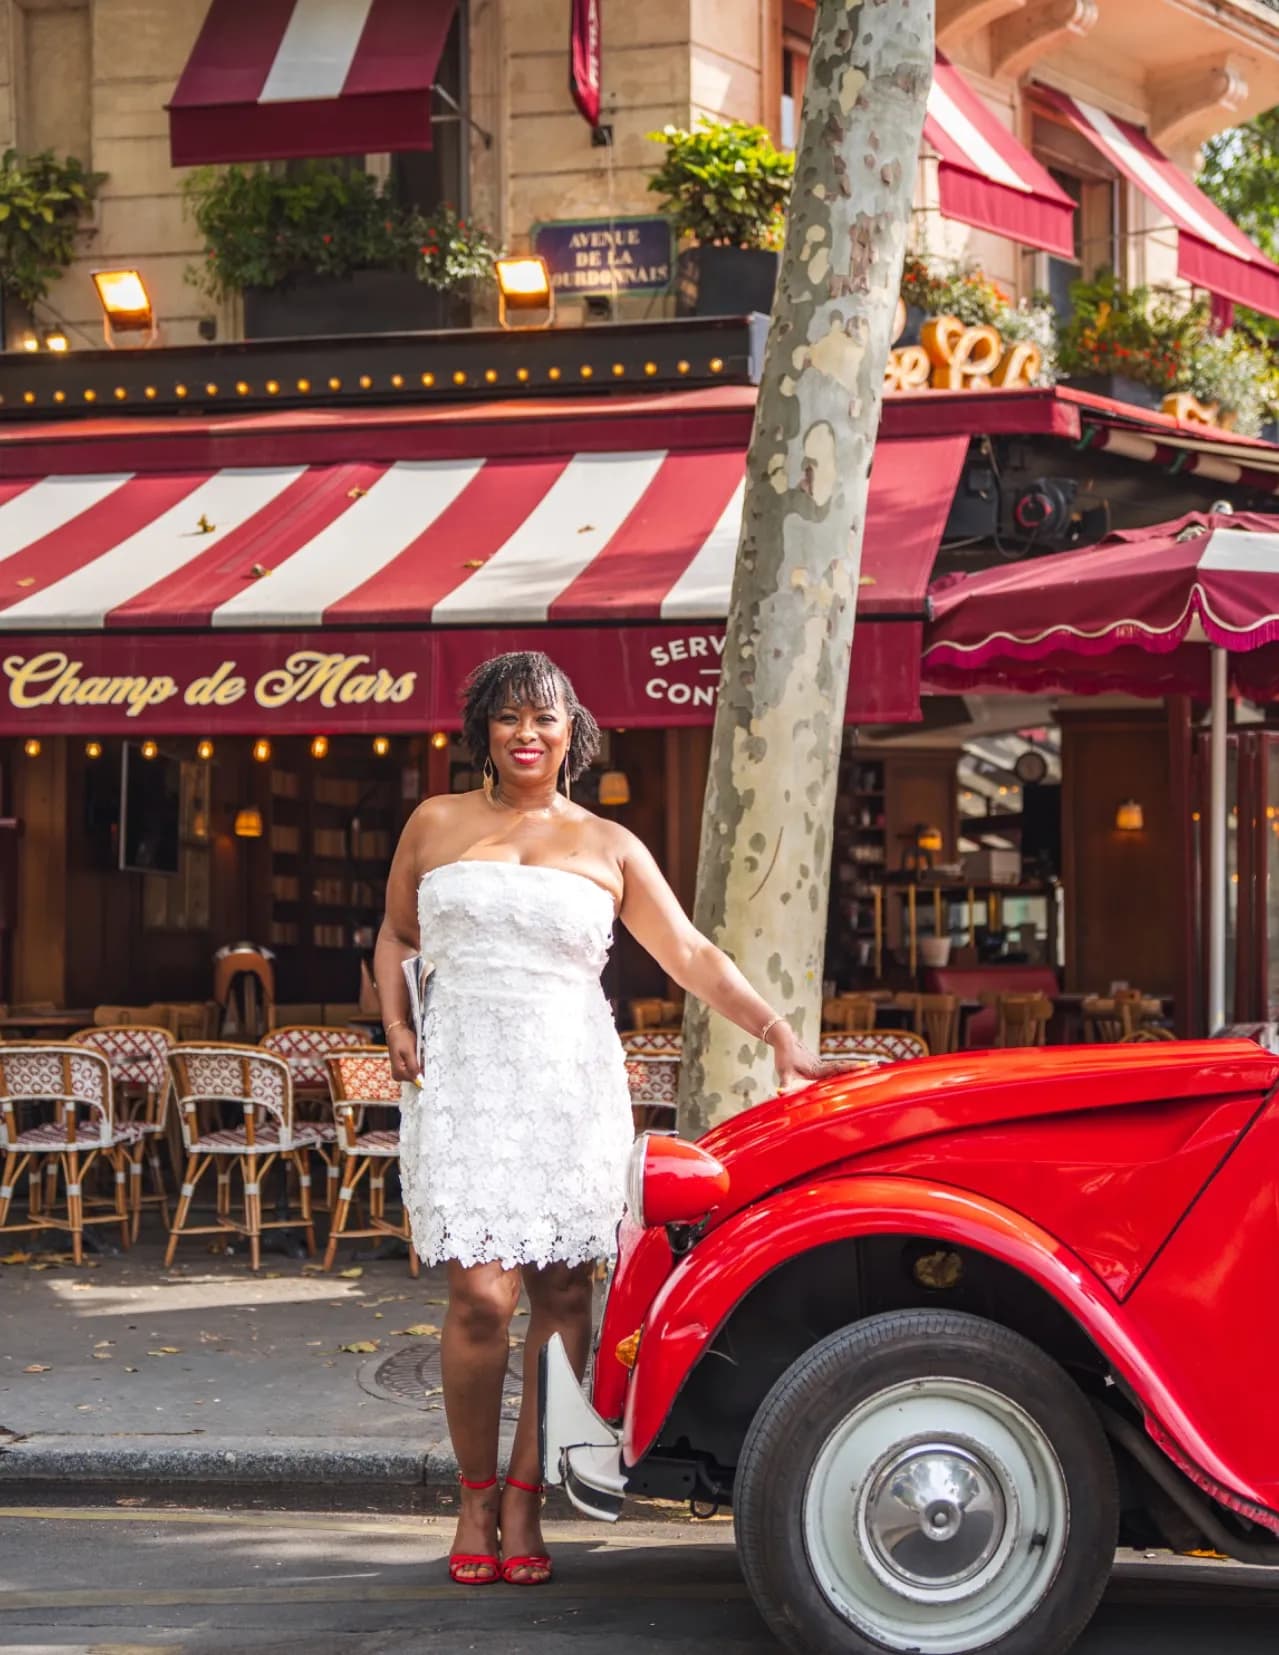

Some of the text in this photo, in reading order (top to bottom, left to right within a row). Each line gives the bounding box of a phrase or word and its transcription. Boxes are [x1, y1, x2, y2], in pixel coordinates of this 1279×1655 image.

[569, 229, 640, 248] AVENUE
[575, 250, 633, 268] DE LA
[551, 265, 669, 287] OURDONNAIS
[650, 635, 727, 667] SERV
[3, 651, 418, 717] Champ de Mars
[645, 678, 720, 707] CON
